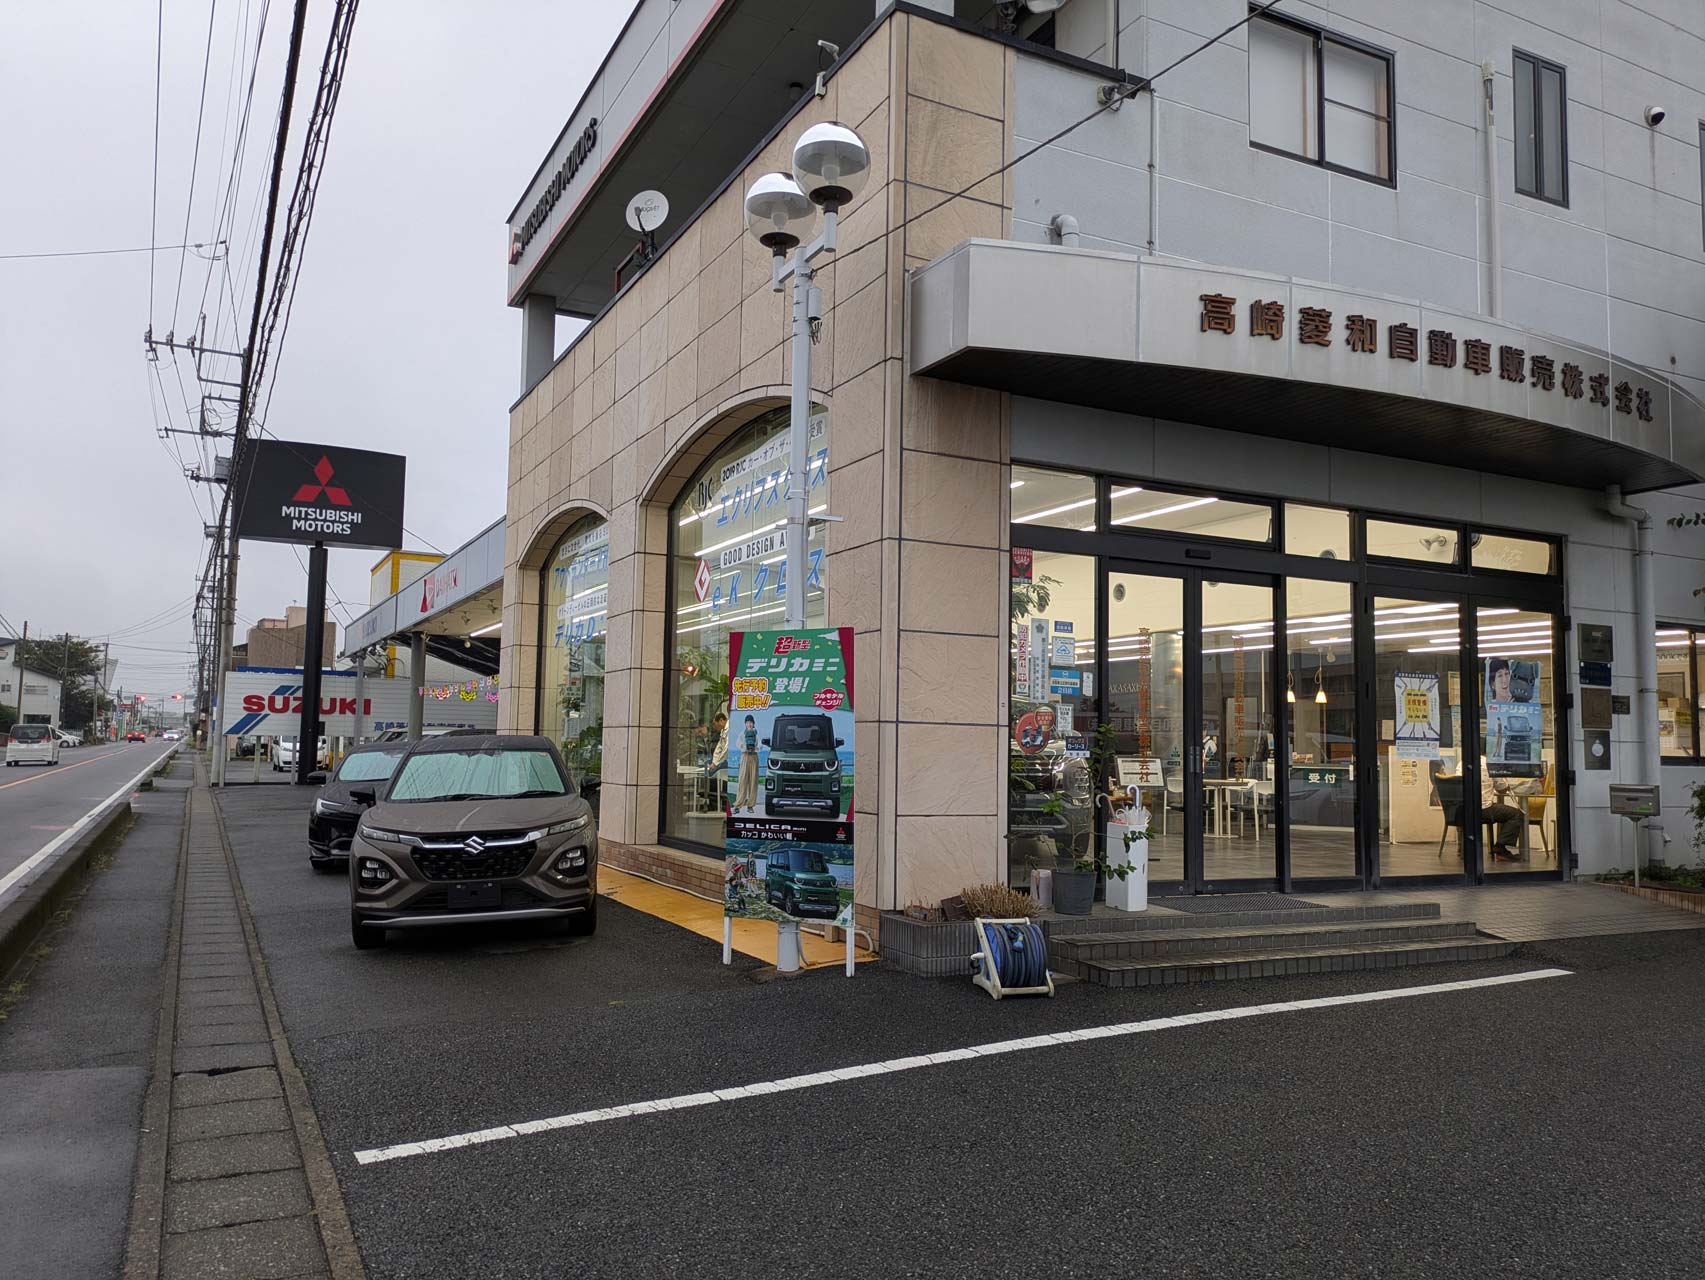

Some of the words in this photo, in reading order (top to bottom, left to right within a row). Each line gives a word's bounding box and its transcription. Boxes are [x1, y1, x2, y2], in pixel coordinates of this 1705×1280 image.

[560, 125, 599, 192] MOTORS
[1199, 292, 1655, 424] 高崎菱和自動車販売株式会社
[721, 465, 736, 483] 2019
[715, 446, 829, 529] エクリプスス
[281, 505, 363, 524] MITSUBISHI
[292, 518, 352, 535] MOTORS
[723, 548, 743, 567] GOOD
[746, 536, 775, 563] DESIGN
[746, 657, 840, 673] デリカミニ
[1308, 772, 1337, 785] 受付
